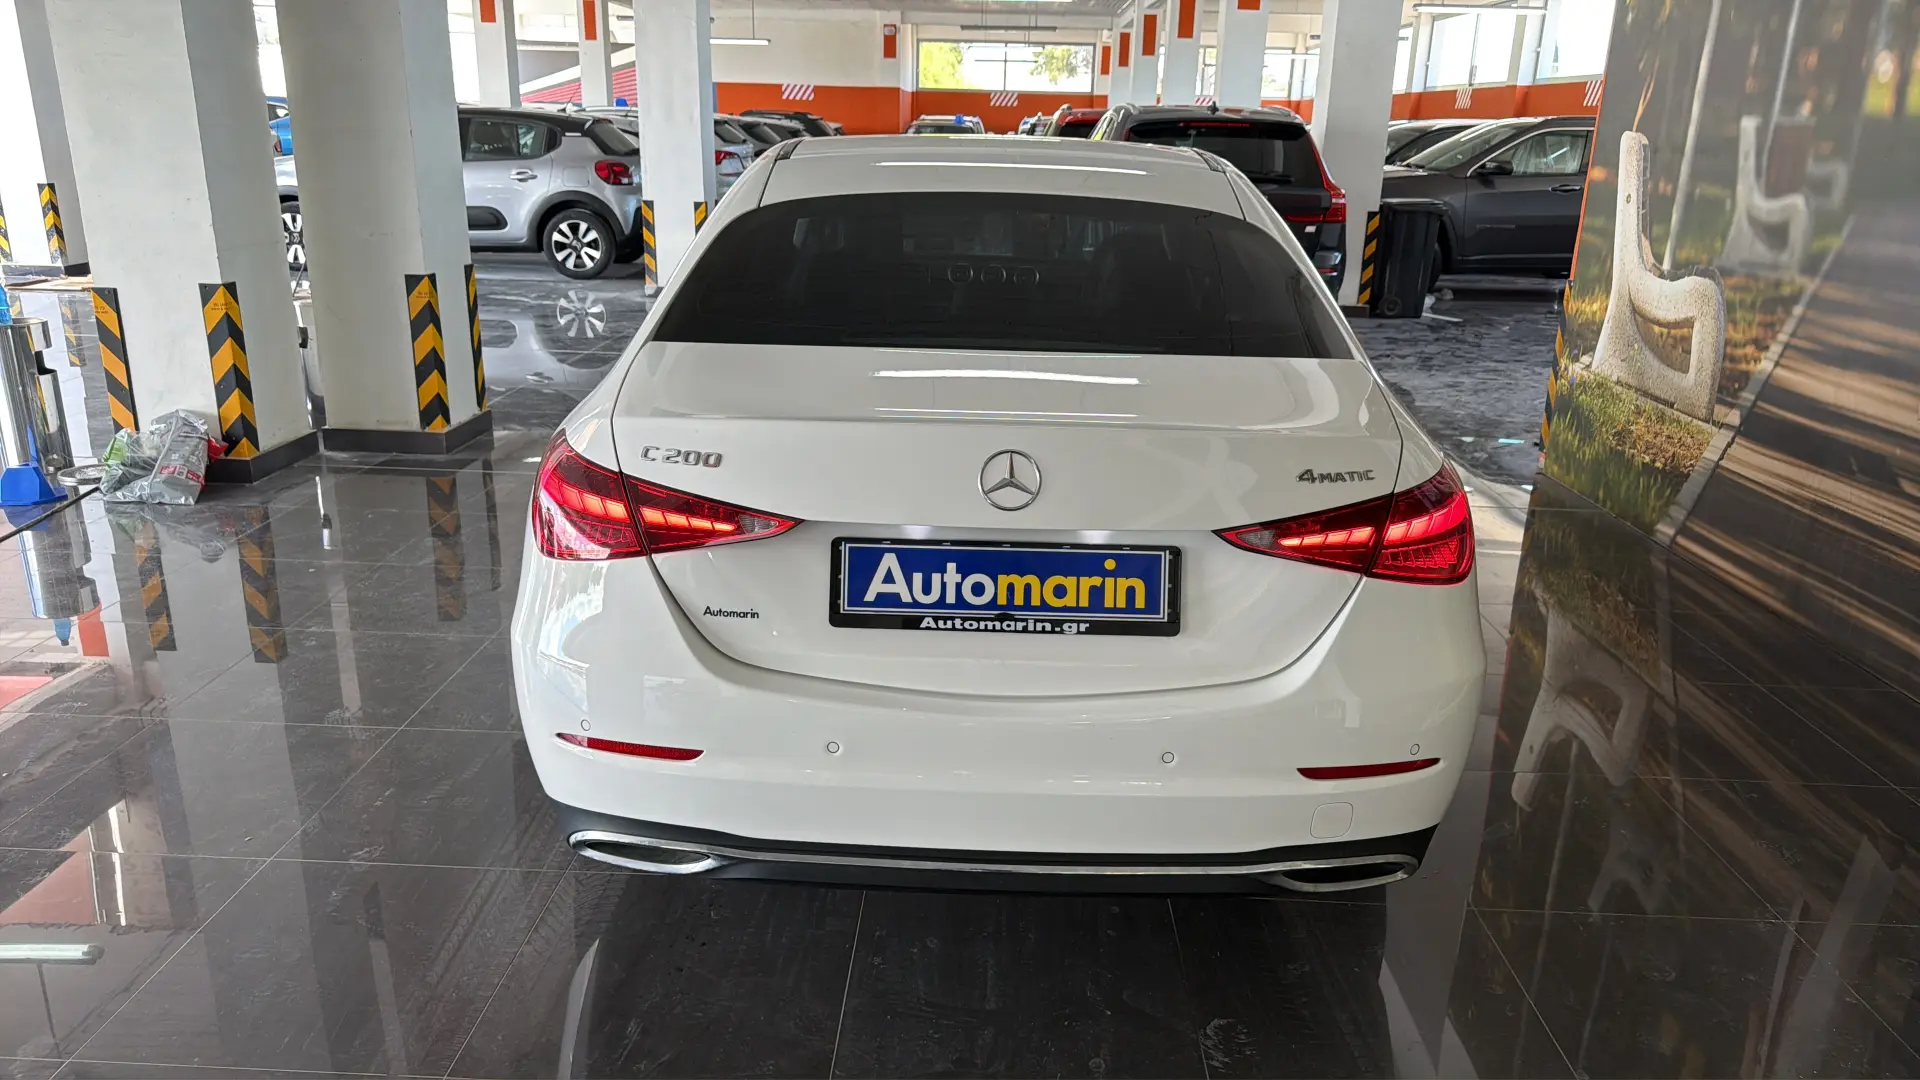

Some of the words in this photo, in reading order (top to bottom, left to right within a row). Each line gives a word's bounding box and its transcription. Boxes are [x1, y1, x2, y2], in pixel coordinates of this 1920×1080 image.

[640, 445, 660, 462] C
[662, 448, 723, 468] 200
[1296, 468, 1376, 484] 4MATIC
[862, 552, 1146, 609] Automarin
[703, 605, 760, 619] Automarin
[919, 616, 1090, 635] Automarin.gr
